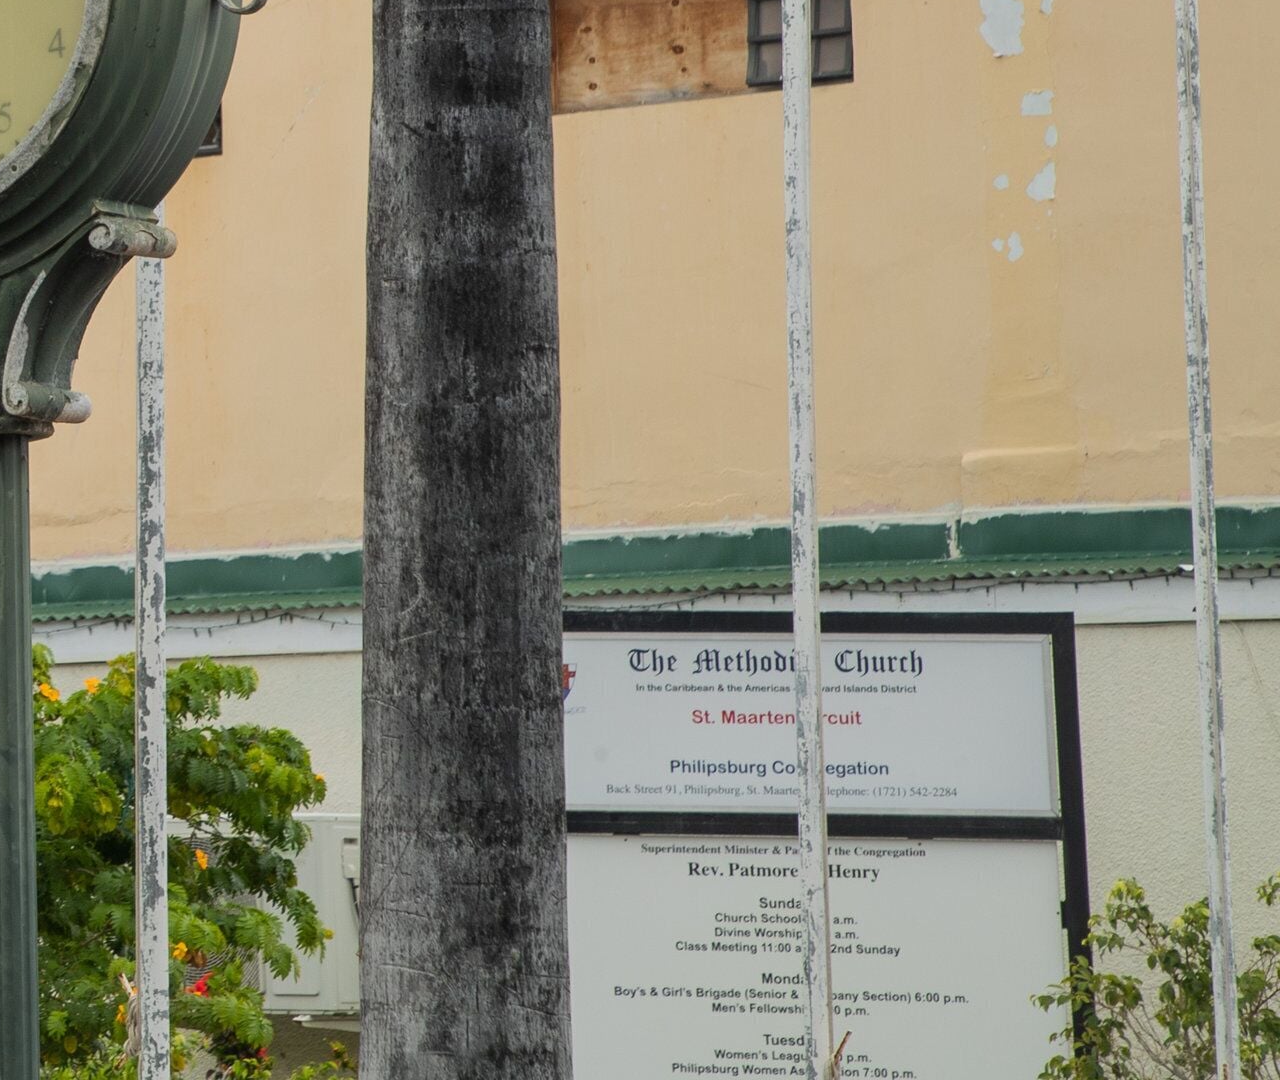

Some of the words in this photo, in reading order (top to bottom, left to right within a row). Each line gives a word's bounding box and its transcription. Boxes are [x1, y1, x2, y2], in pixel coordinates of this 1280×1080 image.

[46, 28, 66, 59] 4
[627, 648, 677, 676] The
[692, 648, 796, 677] Methodi
[834, 649, 923, 678] Church
[635, 684, 645, 692] In
[647, 684, 662, 692] the
[664, 683, 715, 693] Caribbean
[717, 684, 724, 692] &
[727, 684, 742, 692] the
[744, 684, 791, 693] Americas
[843, 684, 878, 693] Islands
[880, 684, 917, 693] District
[692, 709, 715, 724] St.
[721, 709, 796, 725] Maarten
[670, 760, 767, 777] Philipsburg
[772, 760, 889, 778] Coegation
[606, 784, 631, 794] Back
[634, 784, 663, 794] Street
[746, 785, 761, 795] St.
[763, 785, 799, 796] Maarte
[827, 786, 870, 797] lephone:
[872, 786, 907, 798] (1721)
[909, 786, 957, 797] 542-2284
[641, 843, 721, 855] Superintendent
[724, 845, 769, 855] Minister
[772, 845, 781, 855] &
[834, 846, 851, 856] the
[854, 847, 926, 858] Congregation
[688, 862, 724, 877] Rev.
[729, 862, 799, 878] Patmore
[828, 864, 880, 882] Henry
[759, 897, 801, 909] Sunda
[714, 912, 757, 923] Church
[833, 916, 858, 925] a.m.
[714, 927, 751, 937] Divine
[835, 931, 859, 940] a.m.
[675, 941, 708, 952] Class
[711, 942, 758, 954] Meeting
[761, 942, 792, 953] 11:00
[830, 944, 852, 954] 2nd
[856, 944, 900, 957] Sunday
[614, 986, 646, 999] Boy's
[649, 987, 658, 997] &
[662, 987, 692, 997] Girl's
[696, 988, 741, 1000] Brigade
[744, 988, 787, 1000] (Senior
[790, 989, 799, 999] &
[862, 991, 911, 1004] Section)
[914, 992, 940, 1003] 6:00
[943, 995, 969, 1004] p.m.
[711, 1003, 746, 1013] Men's
[749, 1003, 805, 1014] Fellowshi
[844, 1008, 870, 1017] p.m.
[714, 1049, 768, 1061] Women's
[772, 1051, 806, 1062] Leagu
[846, 1055, 872, 1064] p.m.
[672, 1063, 739, 1076] Philipsburg
[742, 1064, 787, 1075] Women
[863, 1068, 888, 1078] 7:00
[891, 1071, 917, 1080] p.m.
